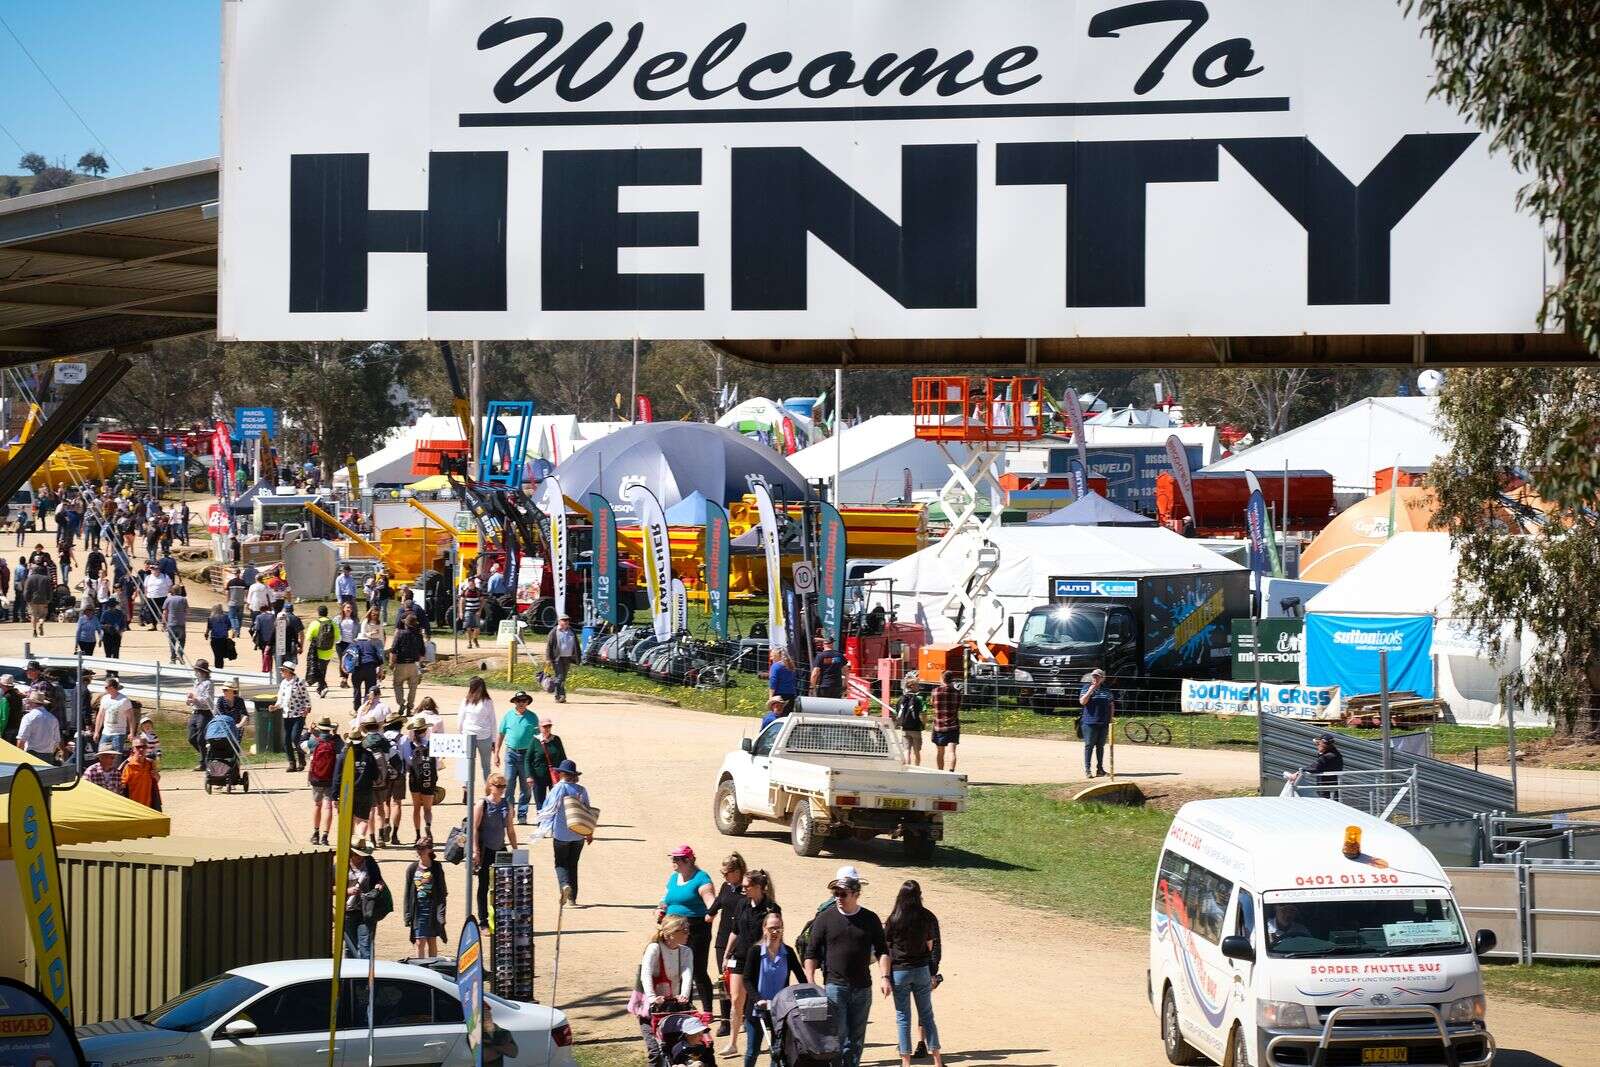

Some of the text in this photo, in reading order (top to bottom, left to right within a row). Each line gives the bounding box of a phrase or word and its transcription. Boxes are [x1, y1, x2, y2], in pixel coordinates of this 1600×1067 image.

[477, 0, 1265, 104] Welcome To
[290, 133, 1480, 314] HENTY
[1085, 463, 1131, 474] ASWELD
[799, 572, 809, 583] 10
[1296, 874, 1399, 886] 0402 013 380
[23, 805, 69, 1020] SHED
[1311, 963, 1441, 974] BORDER SHUTTLE BUS
